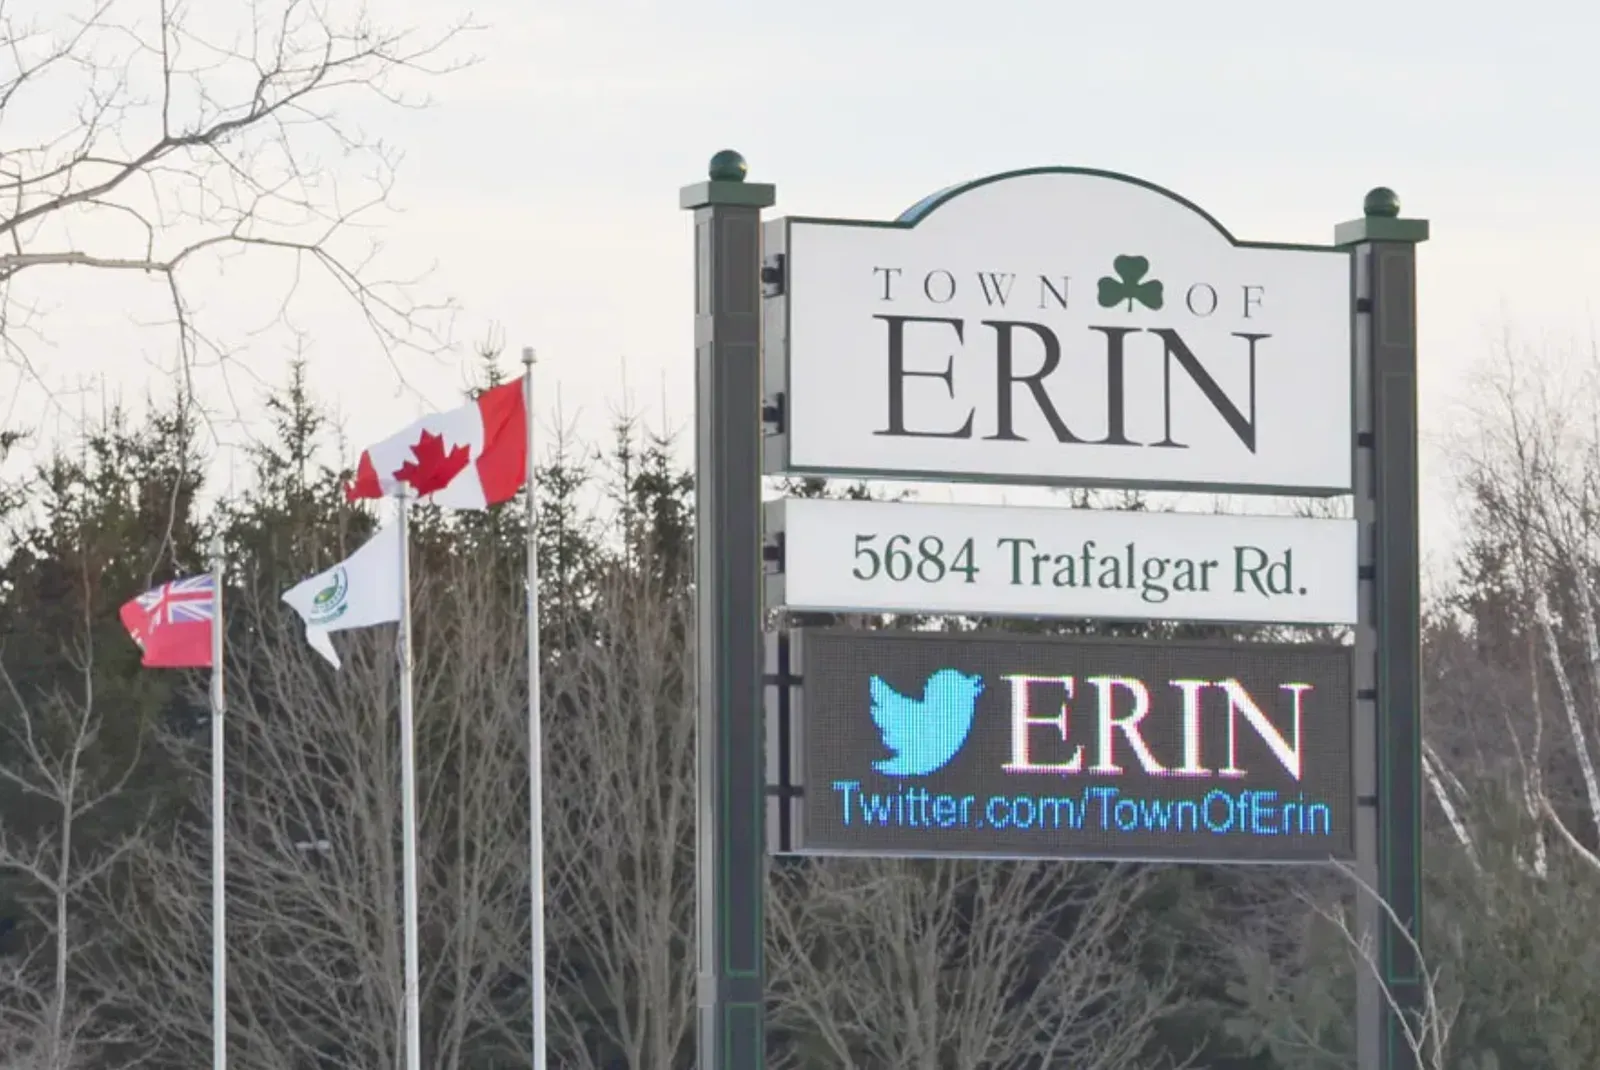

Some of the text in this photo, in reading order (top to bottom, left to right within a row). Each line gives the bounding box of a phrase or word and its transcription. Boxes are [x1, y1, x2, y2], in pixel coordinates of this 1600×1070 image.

[873, 266, 1267, 318] TOWN OF
[872, 313, 1273, 455] ERIN
[852, 534, 1308, 604] 5684 Trafalgar Rd.
[1000, 673, 1313, 780] ERIN
[832, 780, 1331, 837] Twitter.com/TownOfErin
